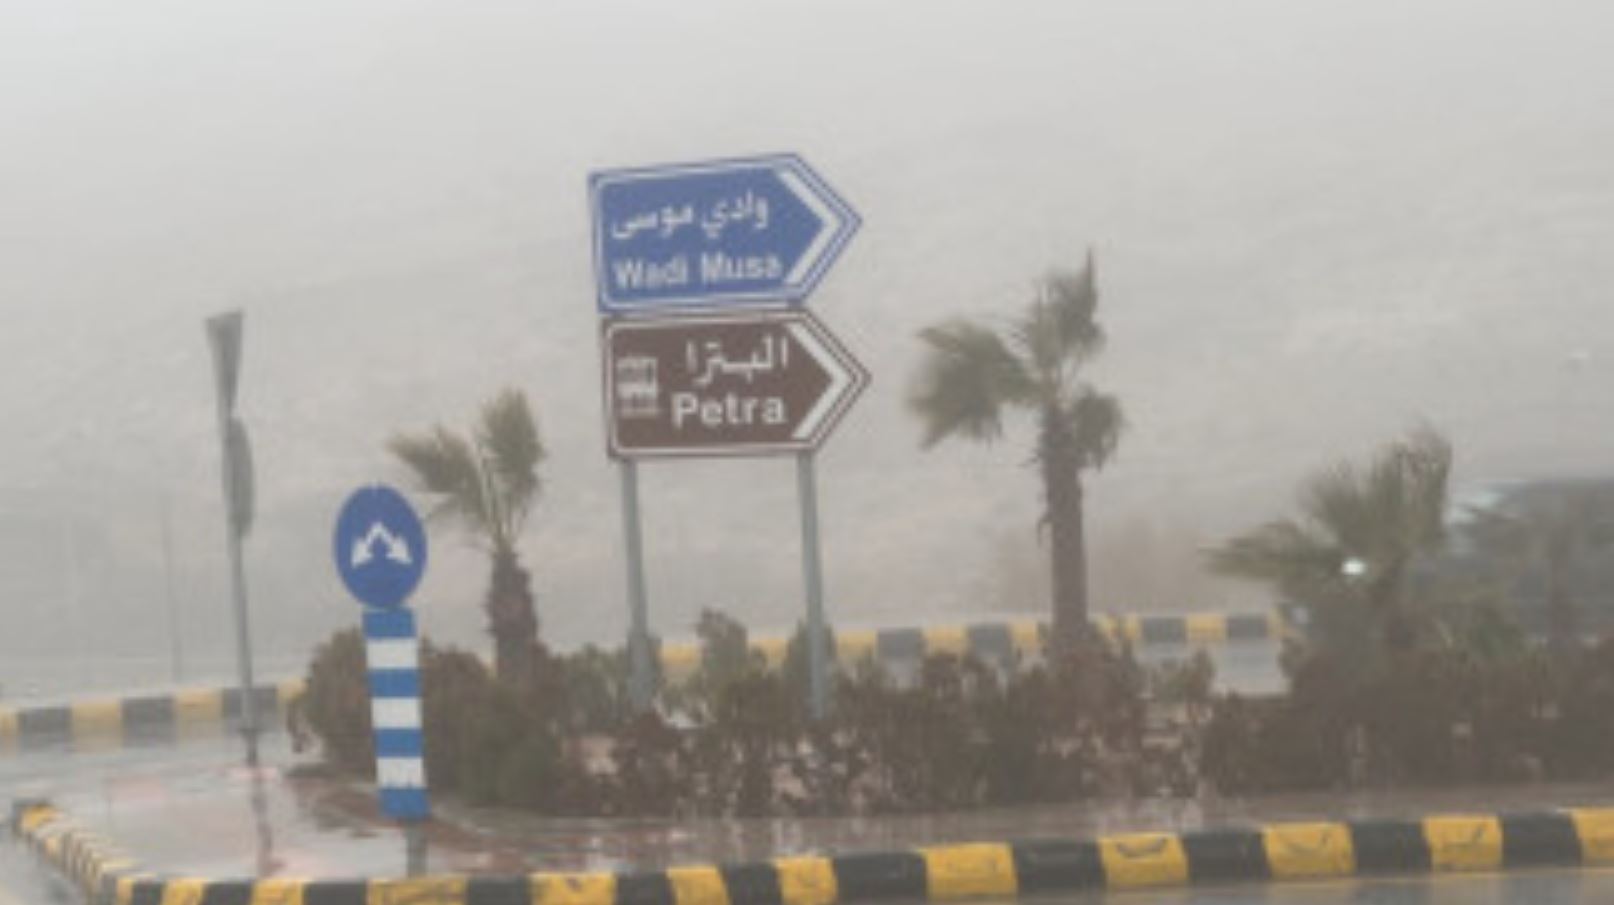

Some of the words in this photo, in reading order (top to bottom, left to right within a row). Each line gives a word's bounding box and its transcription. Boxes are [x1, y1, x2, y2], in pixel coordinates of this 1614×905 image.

[611, 204, 694, 240] موسى
[702, 189, 769, 239] وادي
[613, 254, 688, 289] Wadi
[702, 251, 783, 284] Musa
[686, 334, 788, 387] البترا
[671, 392, 786, 429] Petra
